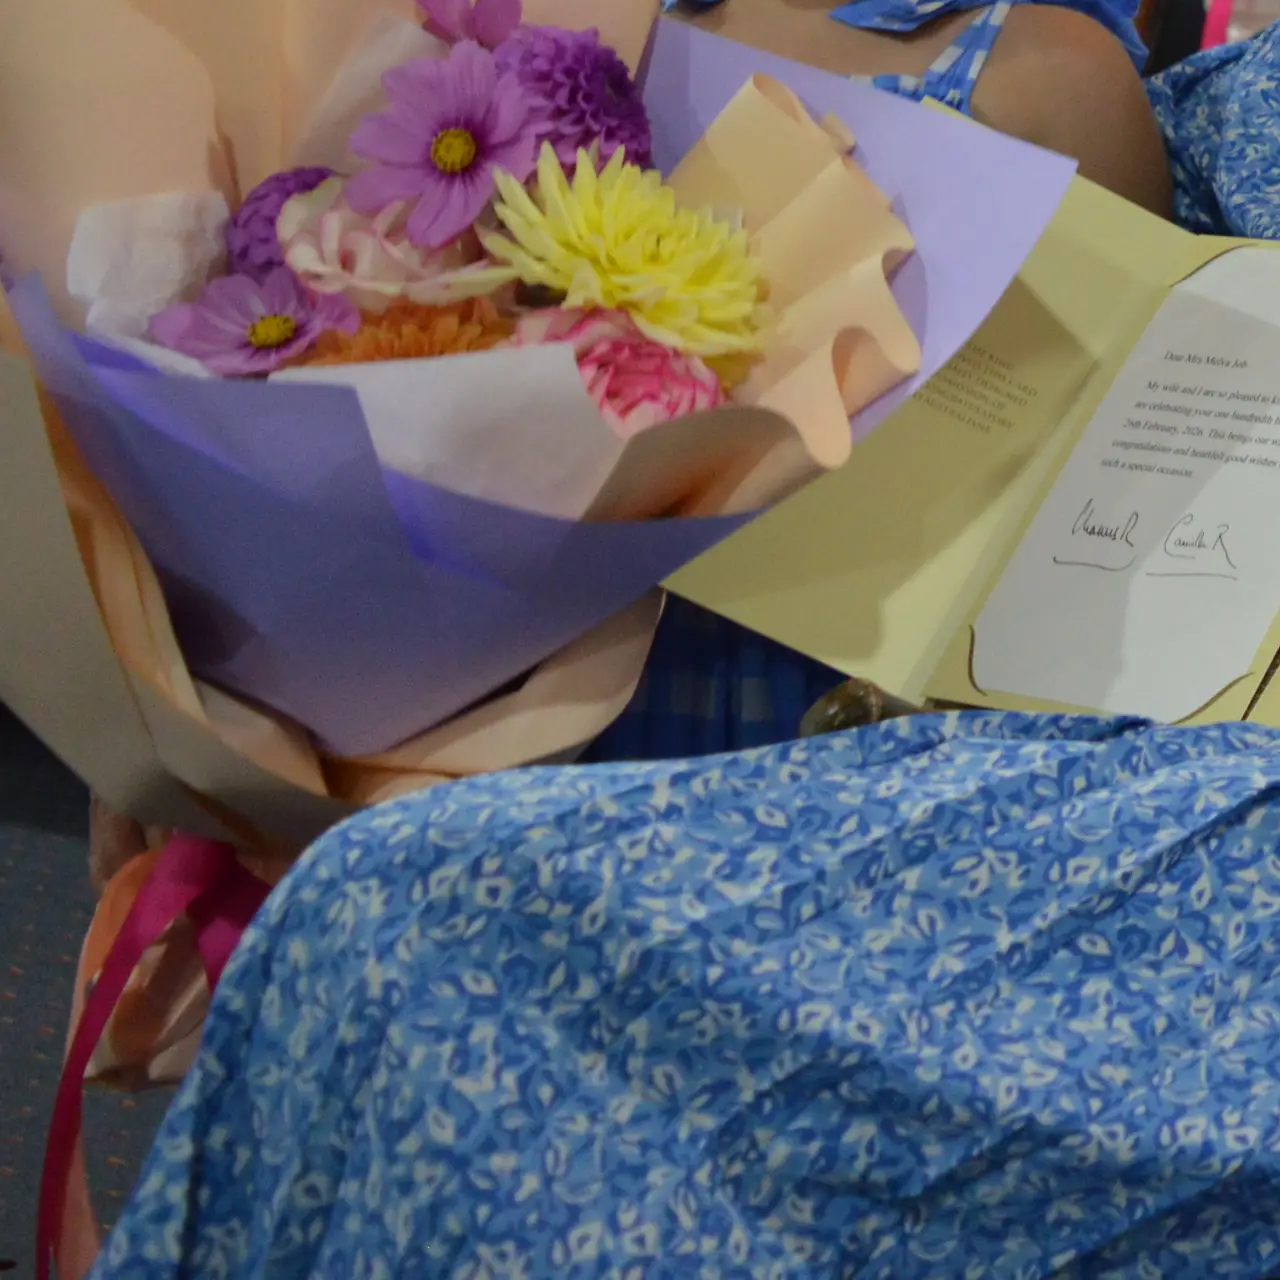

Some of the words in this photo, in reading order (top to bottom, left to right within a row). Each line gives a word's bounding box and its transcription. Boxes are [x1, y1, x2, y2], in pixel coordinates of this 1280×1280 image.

[1163, 350, 1184, 362] Dear
[1184, 354, 1202, 365] Mrs
[1204, 355, 1231, 368] Melva
[1146, 380, 1161, 392] My
[1162, 382, 1181, 393] wife
[1180, 384, 1197, 395] and
[1203, 388, 1217, 397] are
[1226, 389, 1261, 402] pleased
[1133, 400, 1148, 409] are
[1148, 399, 1194, 417] celebrating
[1192, 407, 1214, 418] your
[1214, 410, 1230, 419] one
[1230, 410, 1273, 425] hundredth
[1208, 428, 1226, 440] This
[1227, 431, 1254, 444] brings
[1254, 436, 1270, 445] our
[1111, 437, 1172, 454] congratulations
[1173, 445, 1191, 457] and
[1190, 446, 1226, 462] heartfelt
[1225, 454, 1249, 464] good
[1249, 456, 1278, 468] wishes
[1100, 457, 1120, 467] such
[1126, 462, 1158, 474] special
